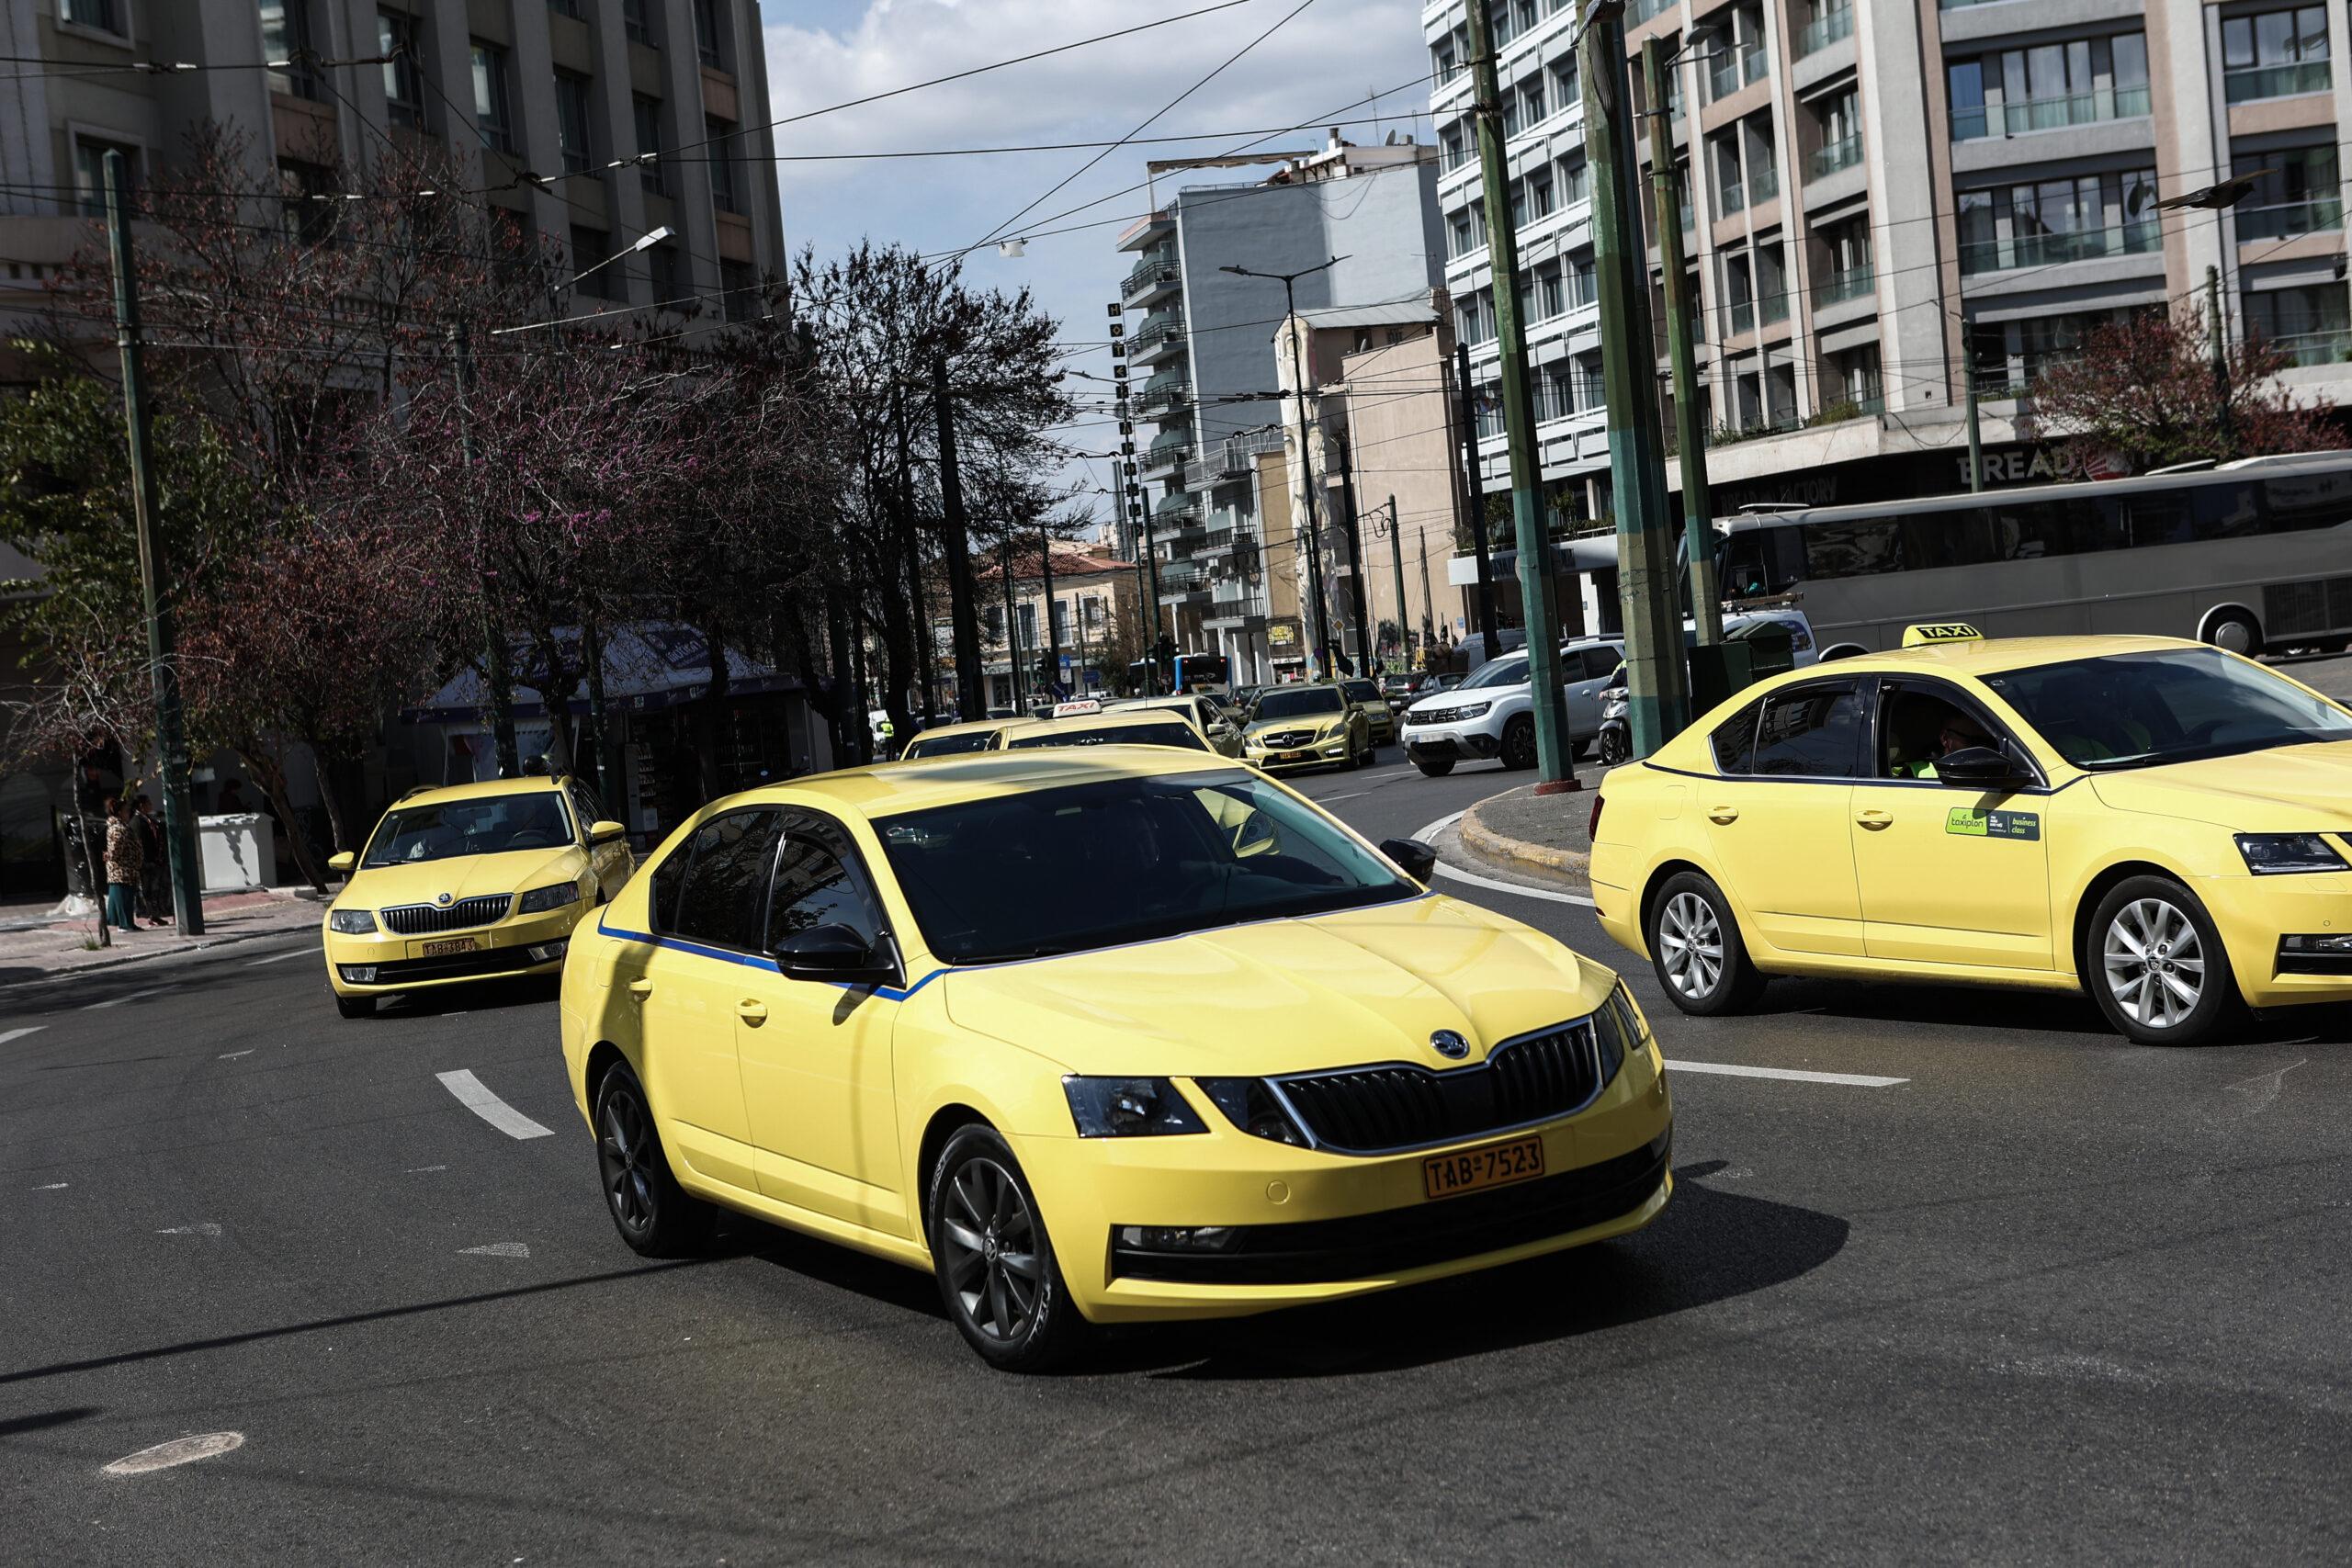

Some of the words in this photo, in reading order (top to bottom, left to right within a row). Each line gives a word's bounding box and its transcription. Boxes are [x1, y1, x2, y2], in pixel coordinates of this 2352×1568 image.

[1920, 626, 1975, 637] TAXI
[1057, 702, 1095, 712] TAXI
[1951, 816, 1984, 829] taxiplon
[2012, 817, 2036, 828] business
[2011, 826, 2026, 834] class
